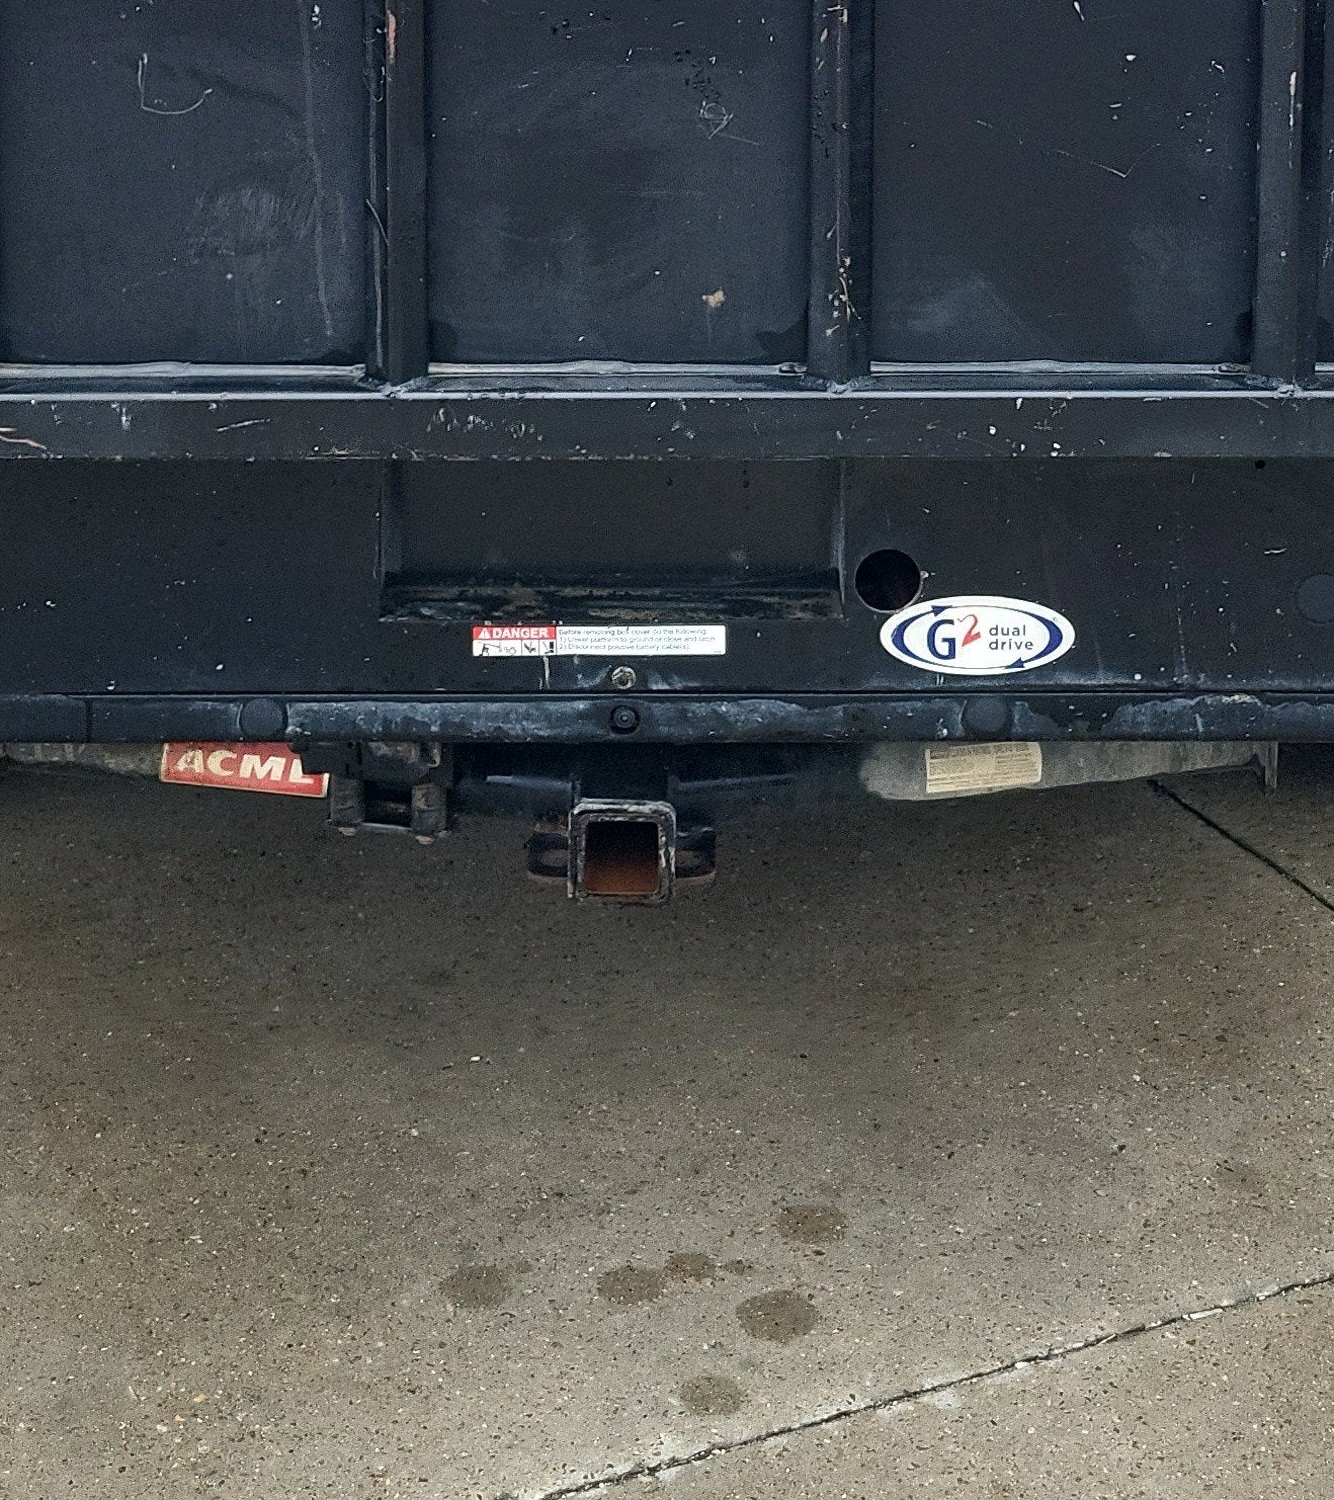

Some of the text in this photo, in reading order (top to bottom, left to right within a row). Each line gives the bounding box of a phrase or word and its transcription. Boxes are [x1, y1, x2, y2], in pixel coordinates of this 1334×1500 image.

[492, 628, 549, 639] DANGER
[989, 625, 1026, 636] dual
[988, 638, 1034, 650] drive
